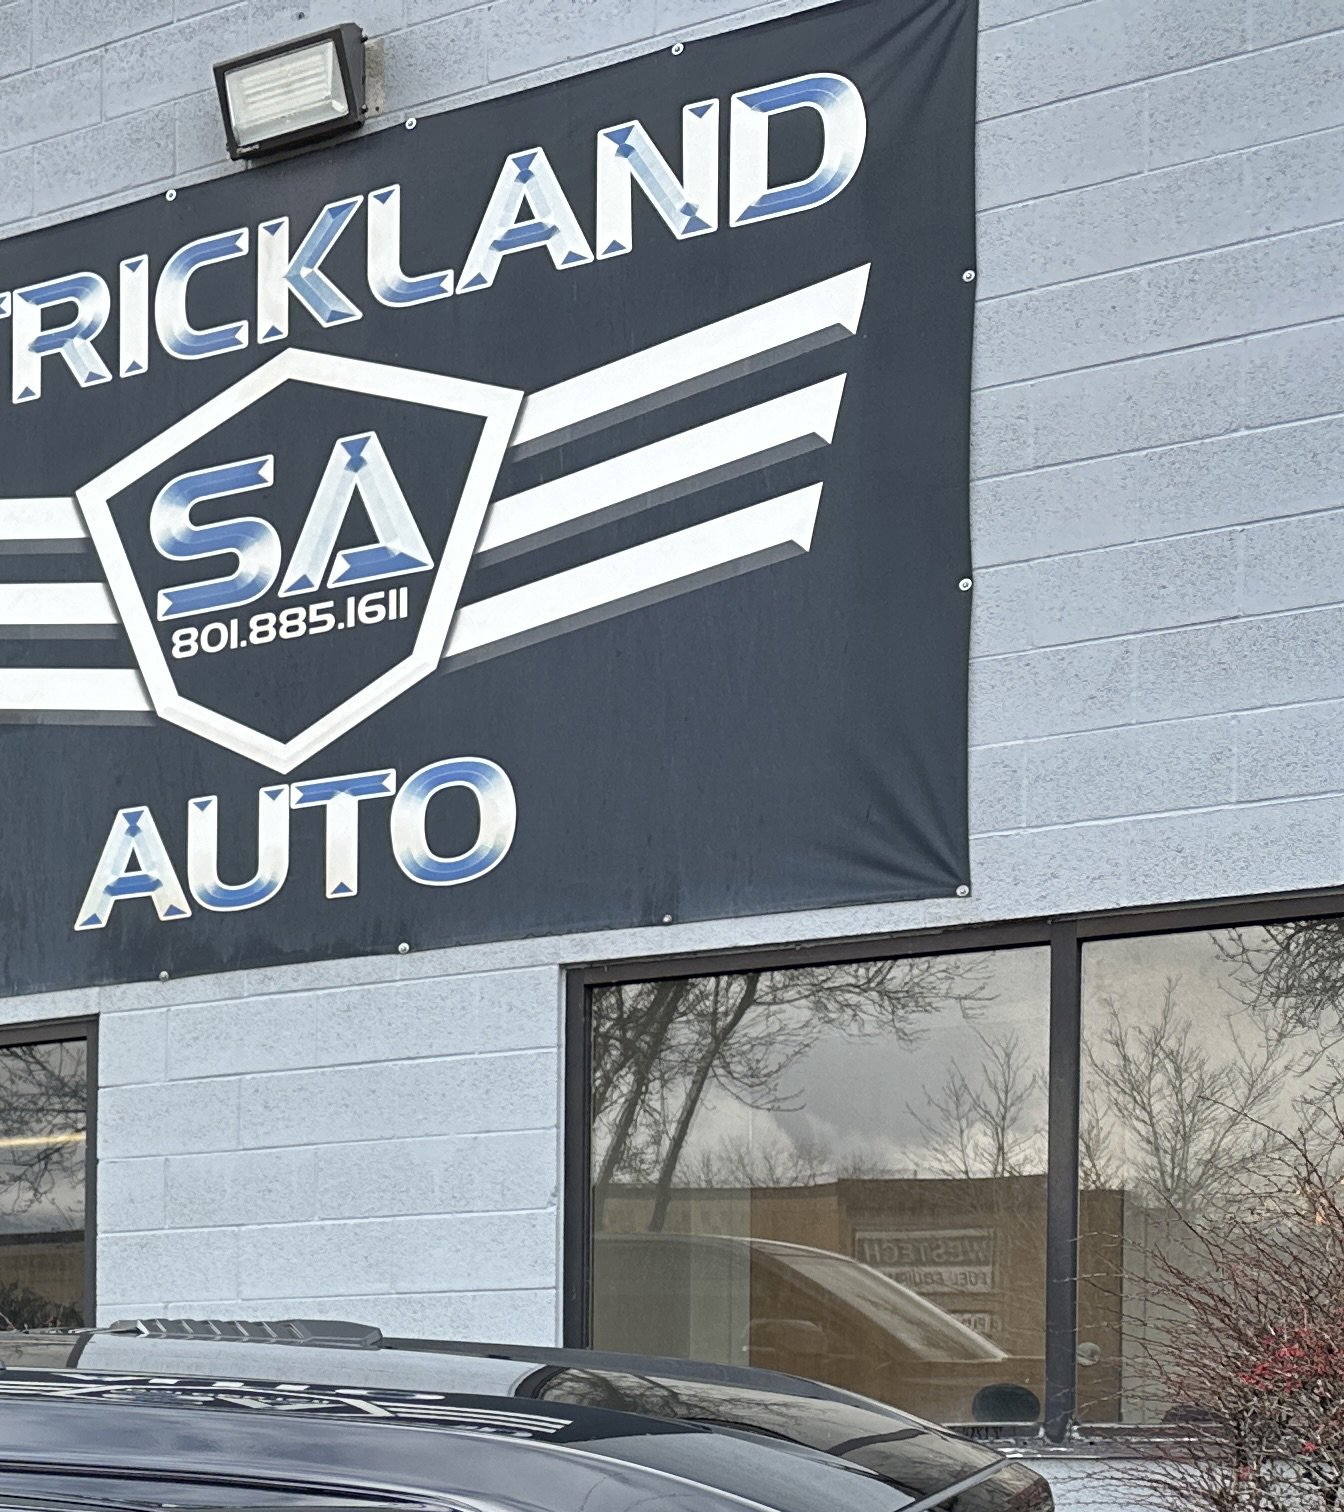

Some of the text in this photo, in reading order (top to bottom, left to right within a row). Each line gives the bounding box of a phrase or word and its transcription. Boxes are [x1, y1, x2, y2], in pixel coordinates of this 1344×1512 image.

[148, 430, 434, 622] SA
[170, 589, 411, 661] 801.885.1611
[73, 756, 518, 932] AUTO
